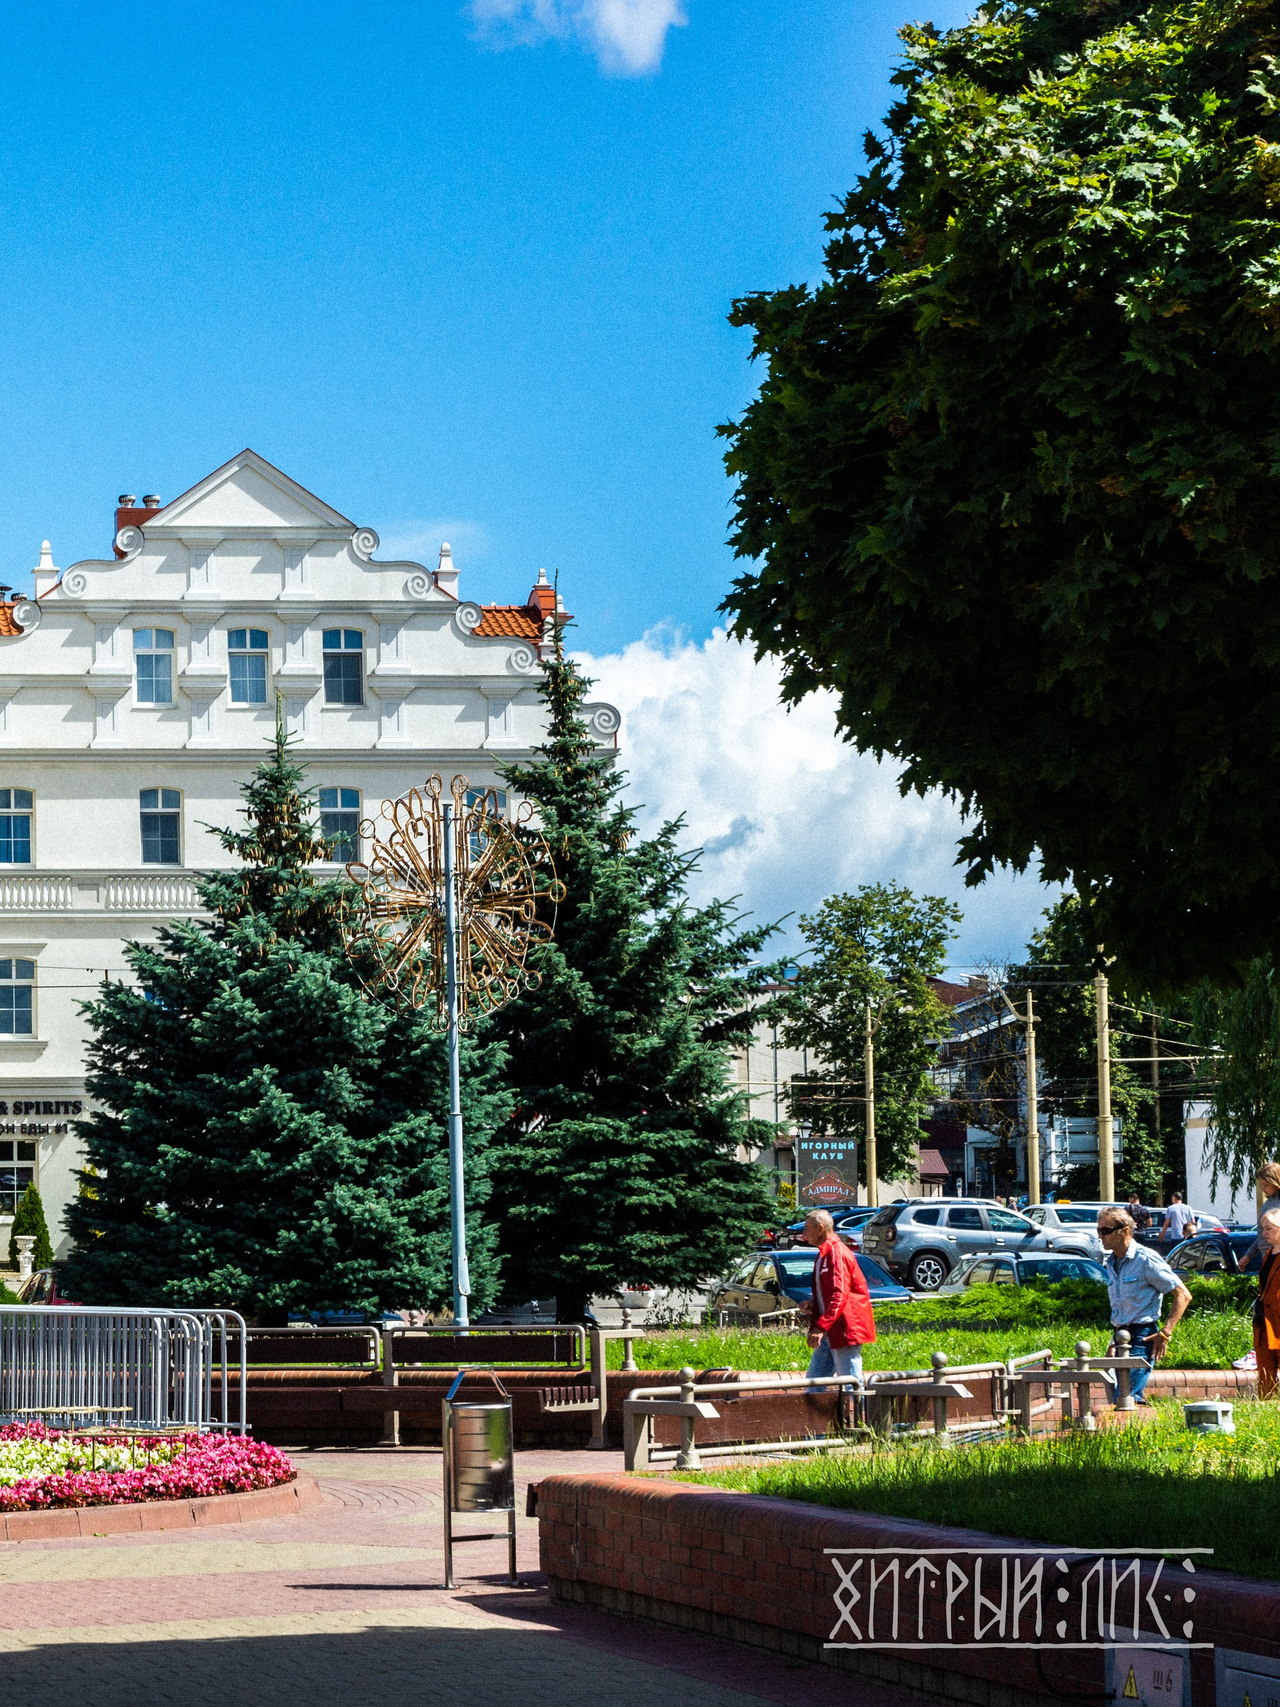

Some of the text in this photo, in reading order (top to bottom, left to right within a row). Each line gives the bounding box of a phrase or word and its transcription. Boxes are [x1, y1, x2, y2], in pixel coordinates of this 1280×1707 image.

[12, 1100, 82, 1115] SPIRITS
[20, 1123, 49, 1135] ЕДЫ
[801, 1141, 855, 1150] ИГОРНЫЙ
[812, 1152, 844, 1160] КЛУБ
[807, 1185, 850, 1197] АДМИРАЛ
